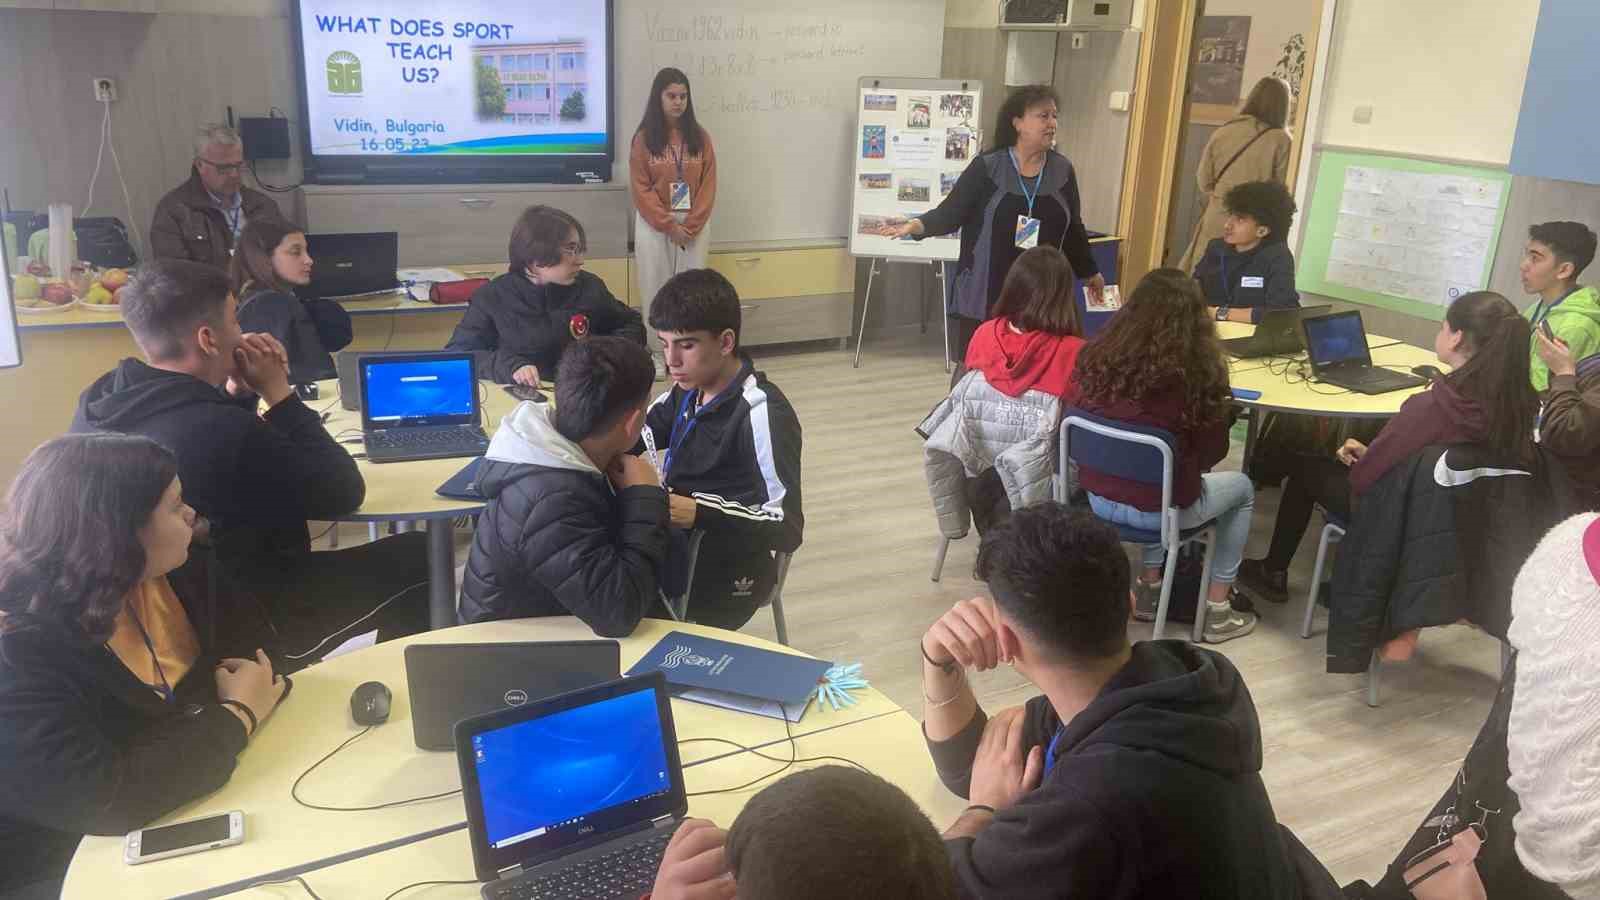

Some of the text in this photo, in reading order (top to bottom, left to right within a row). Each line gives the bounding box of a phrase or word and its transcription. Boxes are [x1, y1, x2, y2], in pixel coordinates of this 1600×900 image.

[315, 14, 513, 40] WHAT DOES SPORT
[386, 42, 452, 61] TEACH
[402, 67, 440, 83] US?
[333, 119, 446, 136] Vidin, Bulgaria
